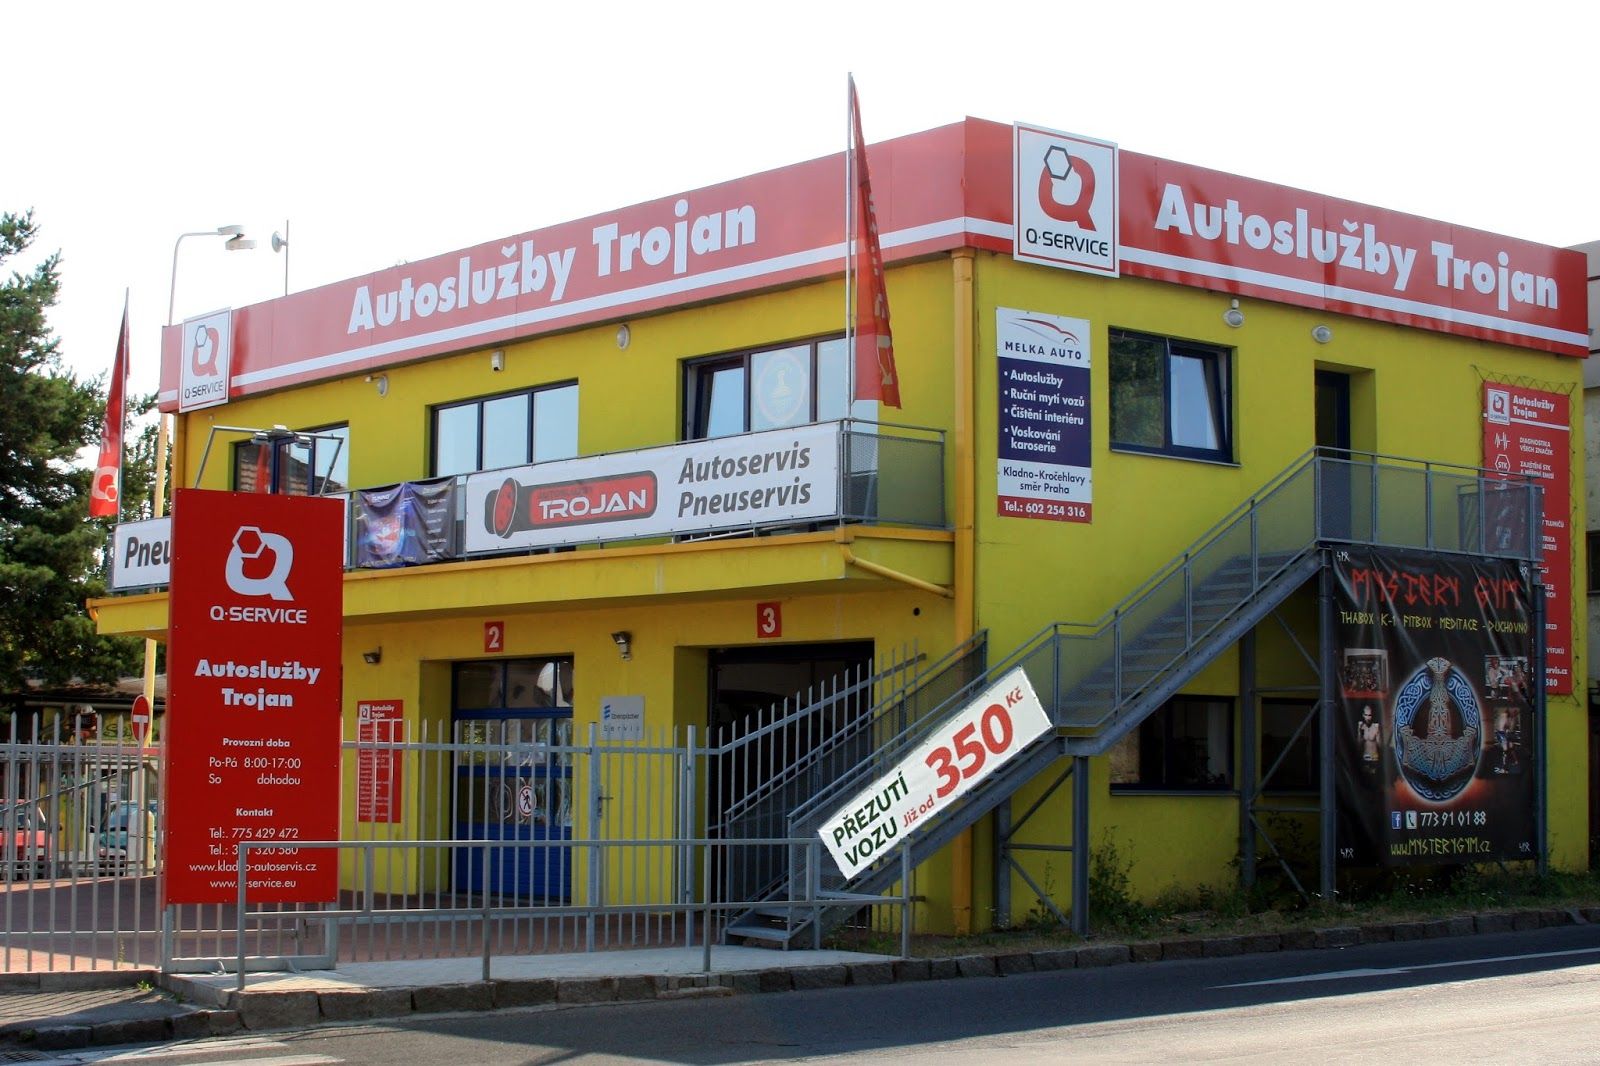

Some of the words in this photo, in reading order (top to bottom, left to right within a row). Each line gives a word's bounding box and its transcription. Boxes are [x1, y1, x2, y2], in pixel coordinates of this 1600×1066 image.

[1153, 183, 1417, 290] Autoslužby
[1431, 240, 1558, 312] Trojan
[347, 239, 576, 334] Autoslužby
[592, 199, 756, 277] Trojan
[1005, 341, 1045, 356] MELKA
[1050, 347, 1082, 360] AUTO
[1010, 369, 1063, 389] Autoslužby
[1010, 387, 1037, 401] Ruční
[1062, 395, 1085, 407] vozů
[1513, 395, 1555, 412] Autoslužby
[1010, 404, 1042, 420] Čištění
[1045, 409, 1084, 425] interiéru
[1512, 406, 1537, 419] Trojan
[1010, 425, 1061, 441] Voskování
[1011, 436, 1056, 453] karoserie
[678, 441, 811, 485] Autoservis
[1003, 466, 1086, 487] Kladno-Kročehlavy
[1020, 481, 1041, 492] směr
[1044, 482, 1070, 494] Praha
[539, 489, 647, 520] TROJAN
[677, 477, 811, 518] Pneuservis
[1004, 501, 1023, 512] Tel.:
[1026, 503, 1044, 514] 602
[1047, 505, 1065, 516] 254
[1067, 507, 1086, 518] 316
[761, 607, 775, 634] 3
[1439, 617, 1478, 631] MEDITACE
[488, 625, 500, 649] 2
[194, 659, 321, 685] Autoslužby
[221, 687, 293, 711] Trojan
[1005, 686, 1024, 708] Kč
[266, 738, 290, 748] doba
[924, 703, 1013, 799] 350
[209, 756, 238, 768] Po-Pá
[244, 758, 301, 769] 8:00-17:00
[208, 773, 222, 785] So
[257, 773, 301, 785] dohodou
[236, 807, 273, 817] Kontakt
[832, 771, 909, 847] PŘEZUTÍ
[918, 795, 935, 814] od
[903, 810, 919, 828] Již
[1420, 811, 1439, 827] 773
[1457, 810, 1470, 827] 01
[1473, 810, 1487, 826] 88
[232, 828, 252, 839] 775
[255, 828, 275, 839] 429
[278, 828, 298, 839] 472
[844, 817, 898, 867] VOZU
[189, 859, 317, 872] www.klado-autoservis.cz
[210, 877, 297, 889] www.-service.eu
